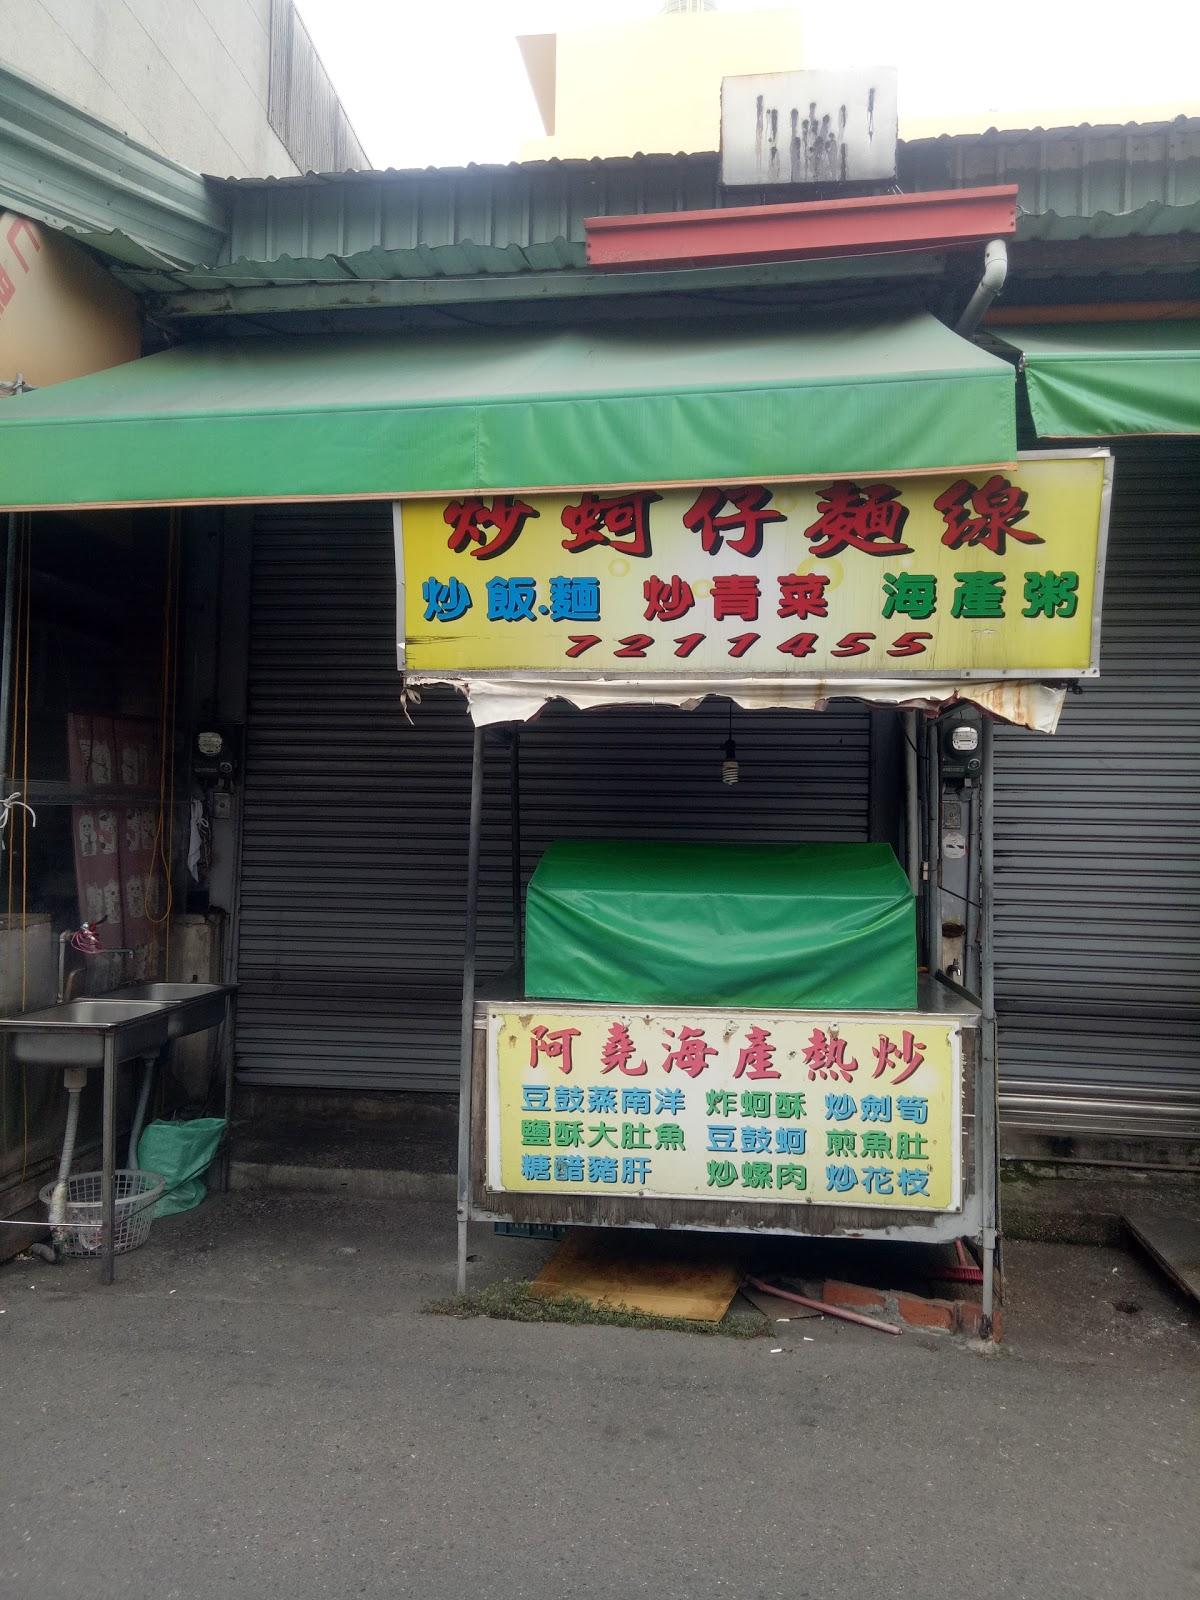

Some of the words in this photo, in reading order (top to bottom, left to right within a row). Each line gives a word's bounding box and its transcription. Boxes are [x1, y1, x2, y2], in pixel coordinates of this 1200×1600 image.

[444, 475, 1045, 558] 炒蚵仔麵線
[643, 574, 830, 620] 炒青菜
[882, 570, 1079, 619] 海產粥
[565, 632, 933, 658] 7211455
[530, 1022, 926, 1084] 阿堯海產熱炒
[705, 1089, 807, 1119] 炸蚵酥
[521, 1119, 686, 1151] 鹽酥大肚魚
[825, 1128, 929, 1160] 煎魚肚
[521, 1154, 652, 1184] 糖醋豬肝
[706, 1159, 807, 1190] 炒螺肉
[825, 1163, 930, 1197] 炒花枝
